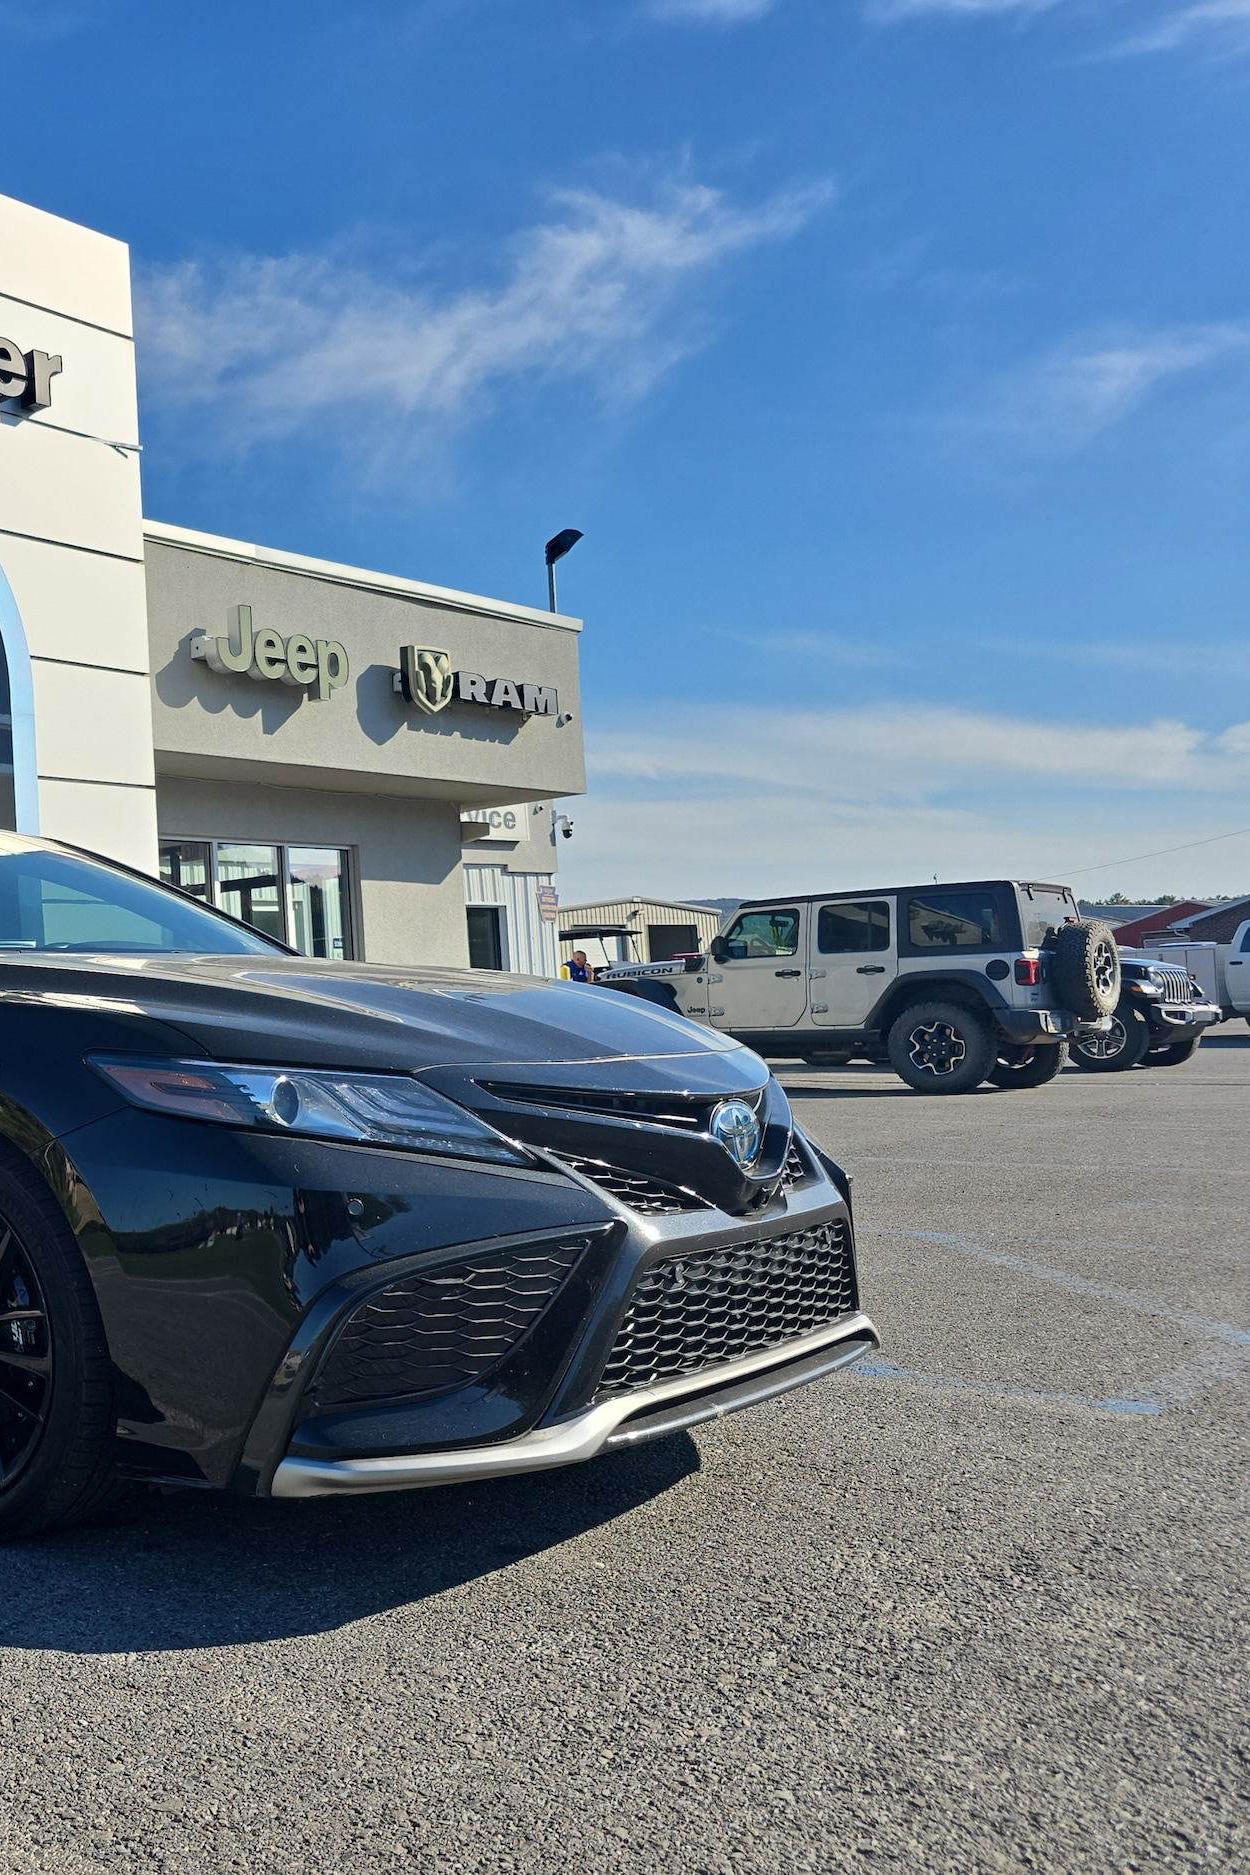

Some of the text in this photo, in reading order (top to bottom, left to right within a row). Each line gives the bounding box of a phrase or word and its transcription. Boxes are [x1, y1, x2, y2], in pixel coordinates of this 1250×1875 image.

[215, 604, 349, 700] Jeep
[456, 671, 559, 715] RAM
[606, 967, 673, 979] RUBICON
